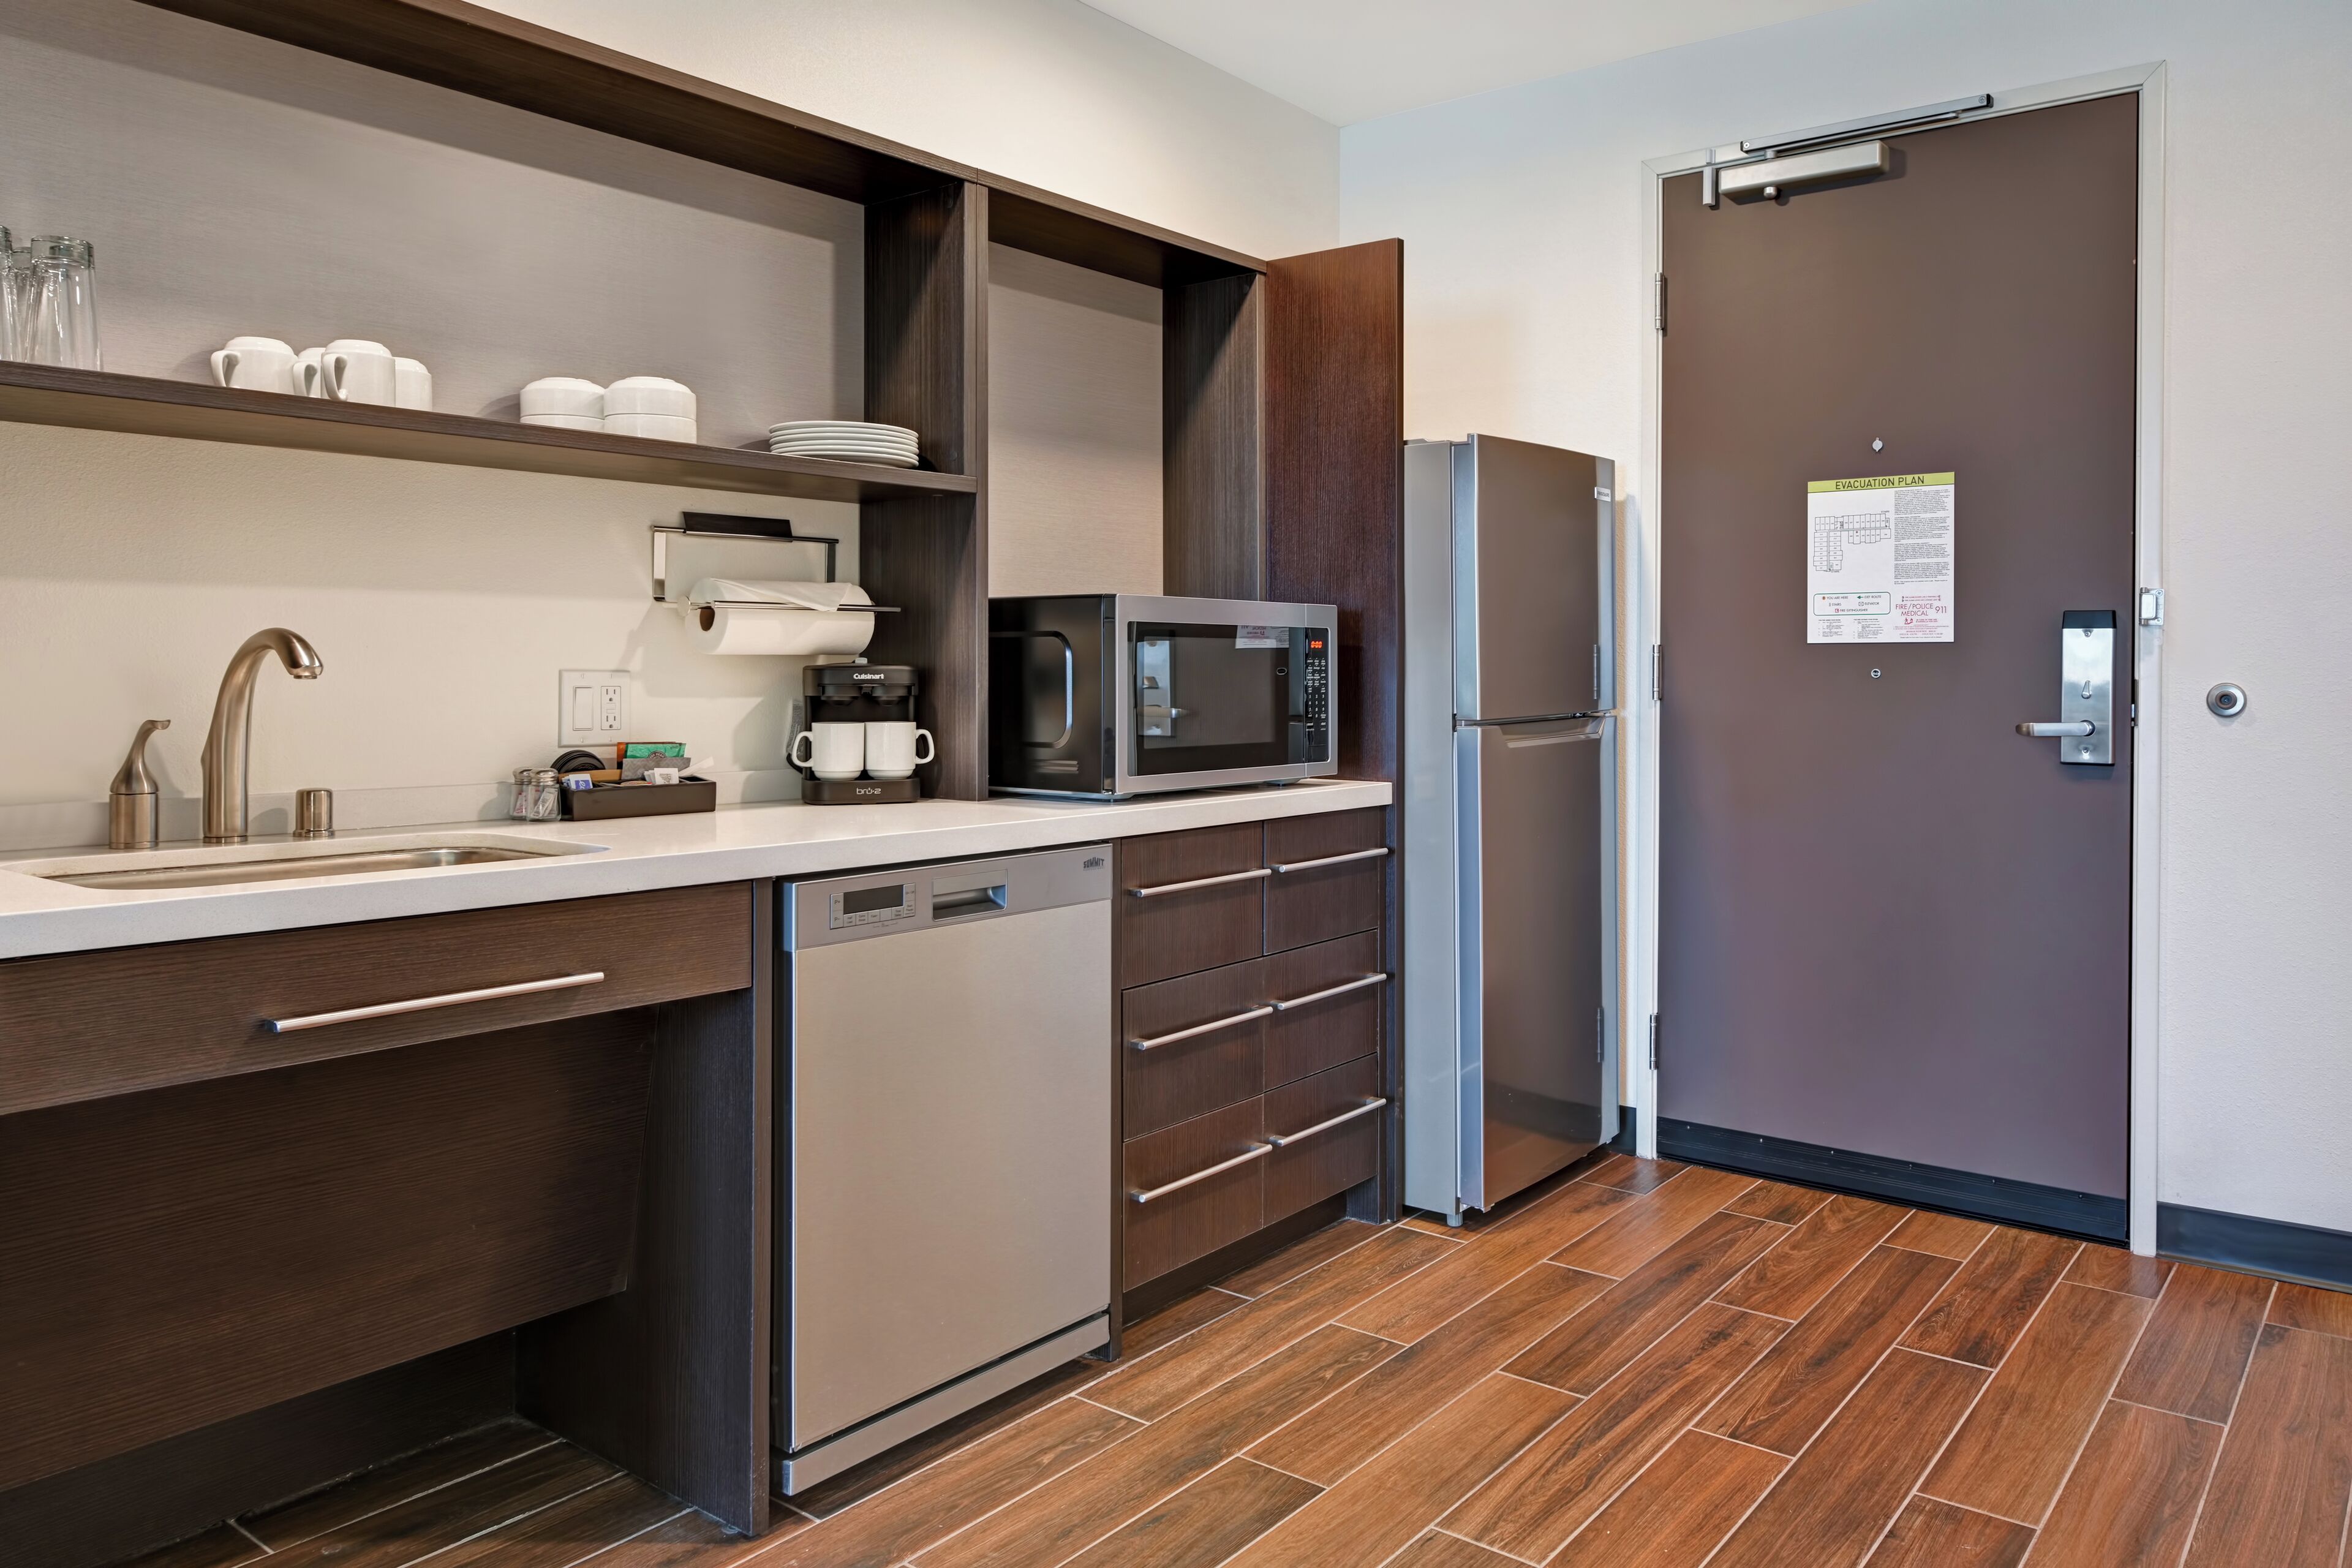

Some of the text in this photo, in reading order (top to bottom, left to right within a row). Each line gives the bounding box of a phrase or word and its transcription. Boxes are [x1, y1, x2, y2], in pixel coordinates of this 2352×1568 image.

[1836, 476, 1924, 490] EVACUATION PLAN
[1083, 857, 1105, 869] SUMMIT
